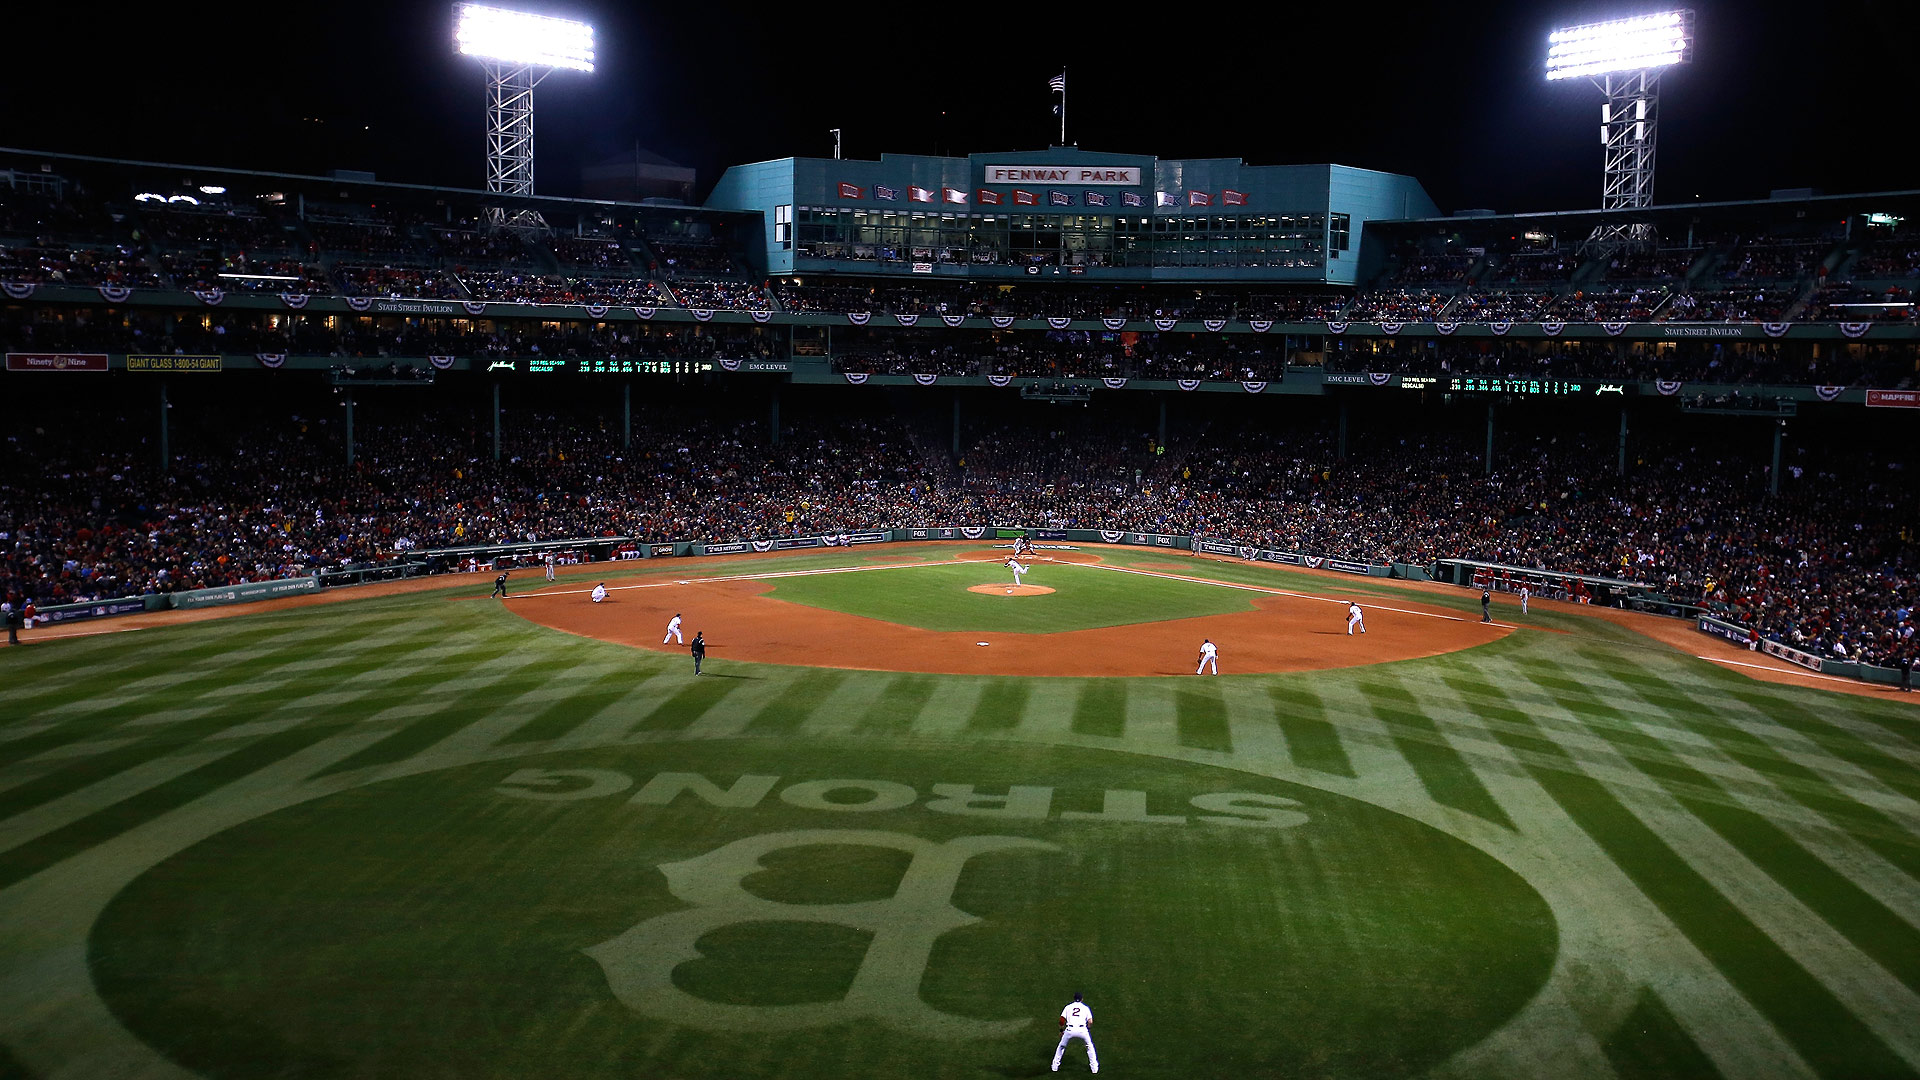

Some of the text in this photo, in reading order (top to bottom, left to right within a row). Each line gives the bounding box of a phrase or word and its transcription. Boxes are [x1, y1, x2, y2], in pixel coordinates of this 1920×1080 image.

[995, 169, 1130, 182] FENWAY PARK
[378, 303, 453, 313] STATE STREET PAVILION
[1665, 327, 1742, 336] STATE STREET PAVILION
[26, 358, 52, 367] Ninety
[68, 358, 86, 366] Nine
[129, 359, 220, 369] GIANT GLASS 1-800-54 GIANT
[1157, 537, 1170, 545] FOX
[494, 766, 1311, 829] STRONG
[580, 828, 1060, 1040] B
[1072, 1007, 1081, 1017] 2
